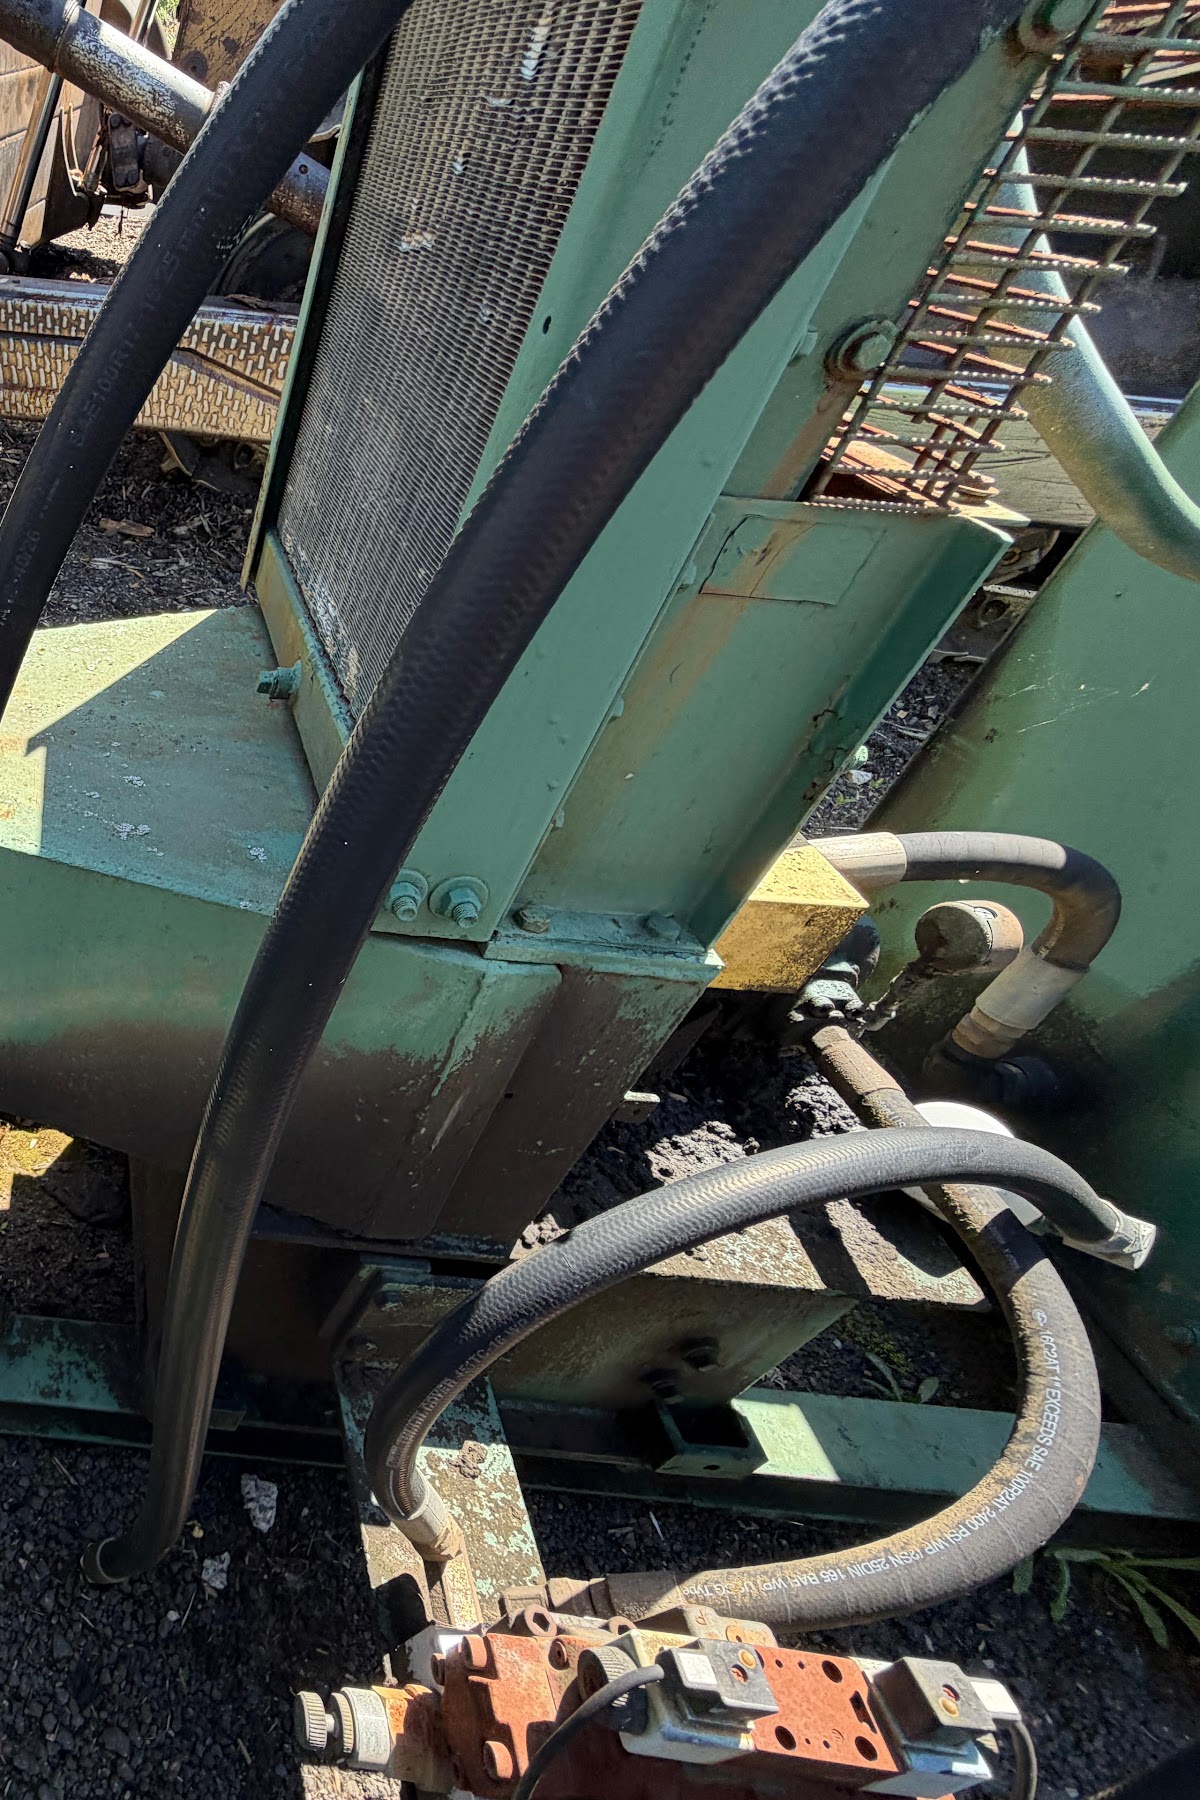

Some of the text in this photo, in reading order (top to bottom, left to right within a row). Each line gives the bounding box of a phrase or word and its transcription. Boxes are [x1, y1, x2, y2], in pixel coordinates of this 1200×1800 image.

[1039, 1329, 1060, 1373] 16C2AT
[1036, 1388, 1060, 1446] EXCEEDS
[1024, 1445, 1048, 1471] SAE
[994, 1470, 1034, 1512] 100R2AT
[965, 1506, 996, 1530] 2400
[924, 1536, 950, 1556] WP
[944, 1524, 971, 1547] PSI
[847, 1557, 890, 1579] 25DIN
[888, 1549, 924, 1568] (2SN
[820, 1568, 846, 1583] 165
[683, 1584, 713, 1597] Type
